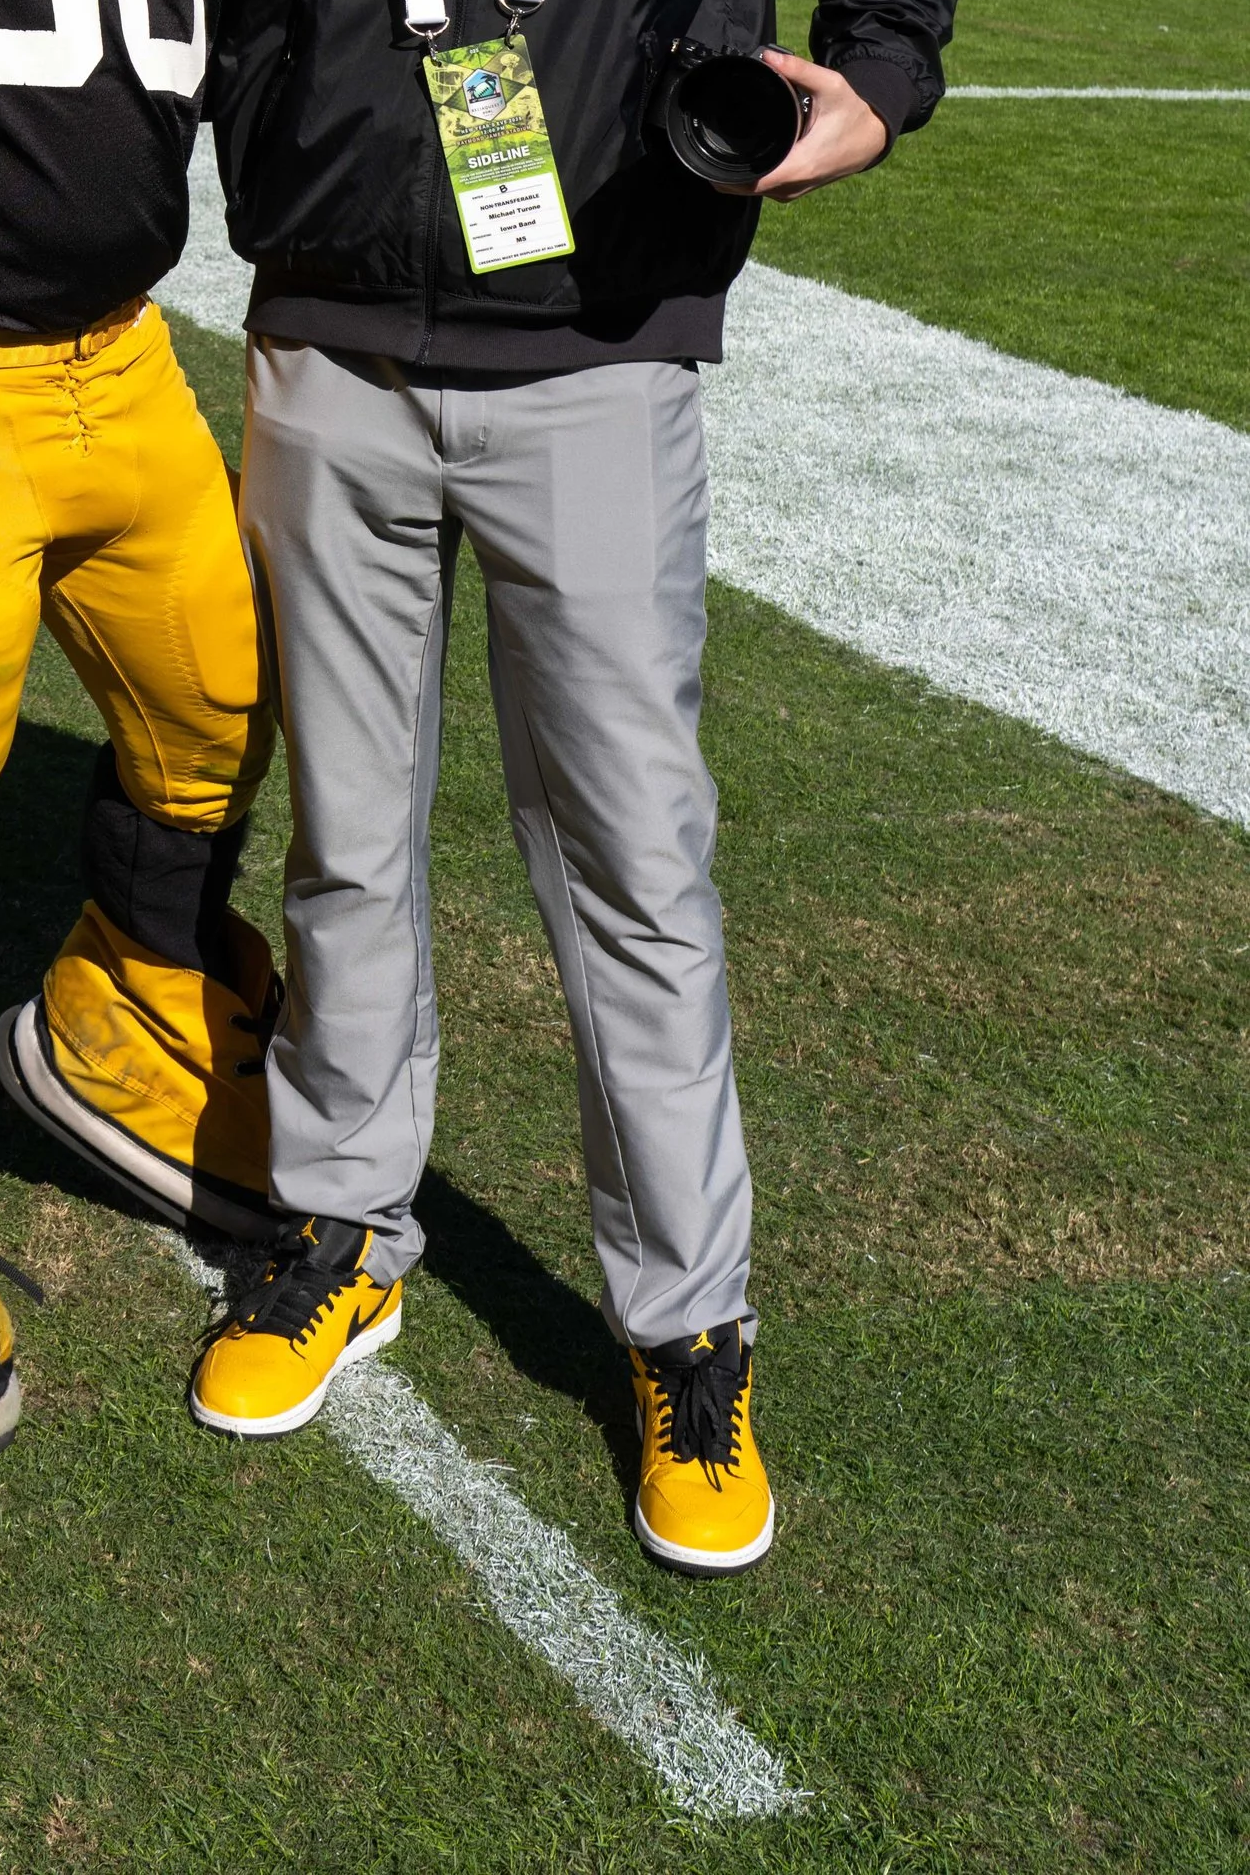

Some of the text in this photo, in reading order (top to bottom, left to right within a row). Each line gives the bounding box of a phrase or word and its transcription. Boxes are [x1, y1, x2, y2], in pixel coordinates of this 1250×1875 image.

[506, 125, 531, 136] STADIUM
[468, 145, 531, 169] SIDELINE
[499, 185, 508, 193] B
[480, 193, 540, 211] NON-TRANSFERABLE
[489, 204, 541, 220] Michael Turone
[500, 219, 536, 232] Iowa Band
